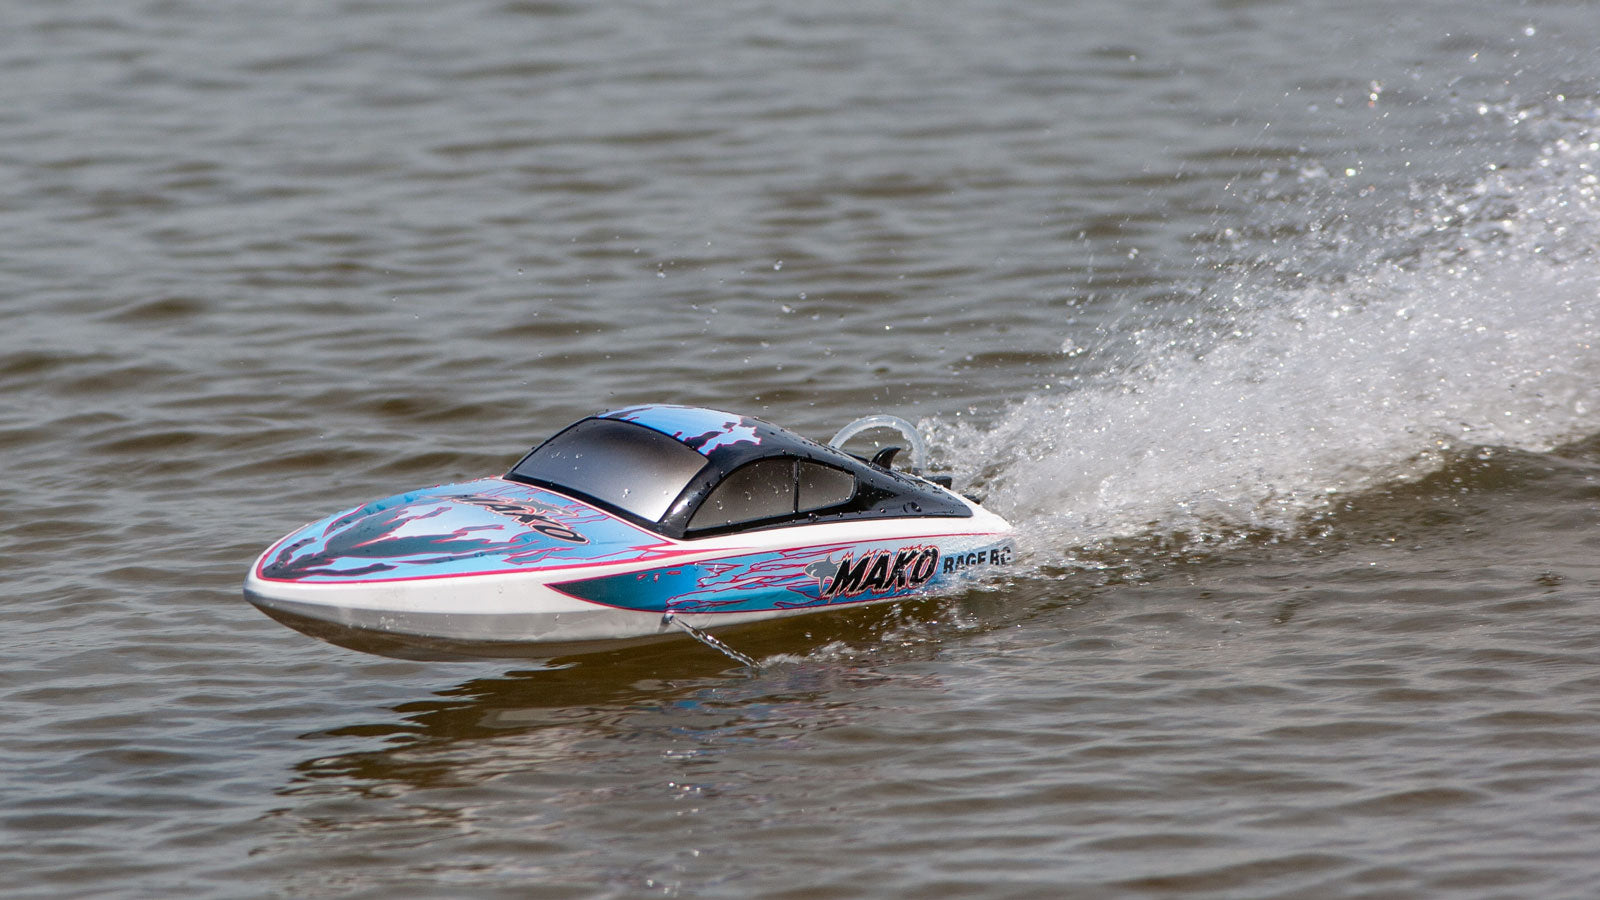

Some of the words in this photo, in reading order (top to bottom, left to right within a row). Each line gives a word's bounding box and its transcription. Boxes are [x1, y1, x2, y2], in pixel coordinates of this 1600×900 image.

[450, 494, 590, 544] MAKO
[824, 547, 940, 597] MAKO
[942, 550, 987, 574] RAGE
[989, 546, 1012, 566] RC
